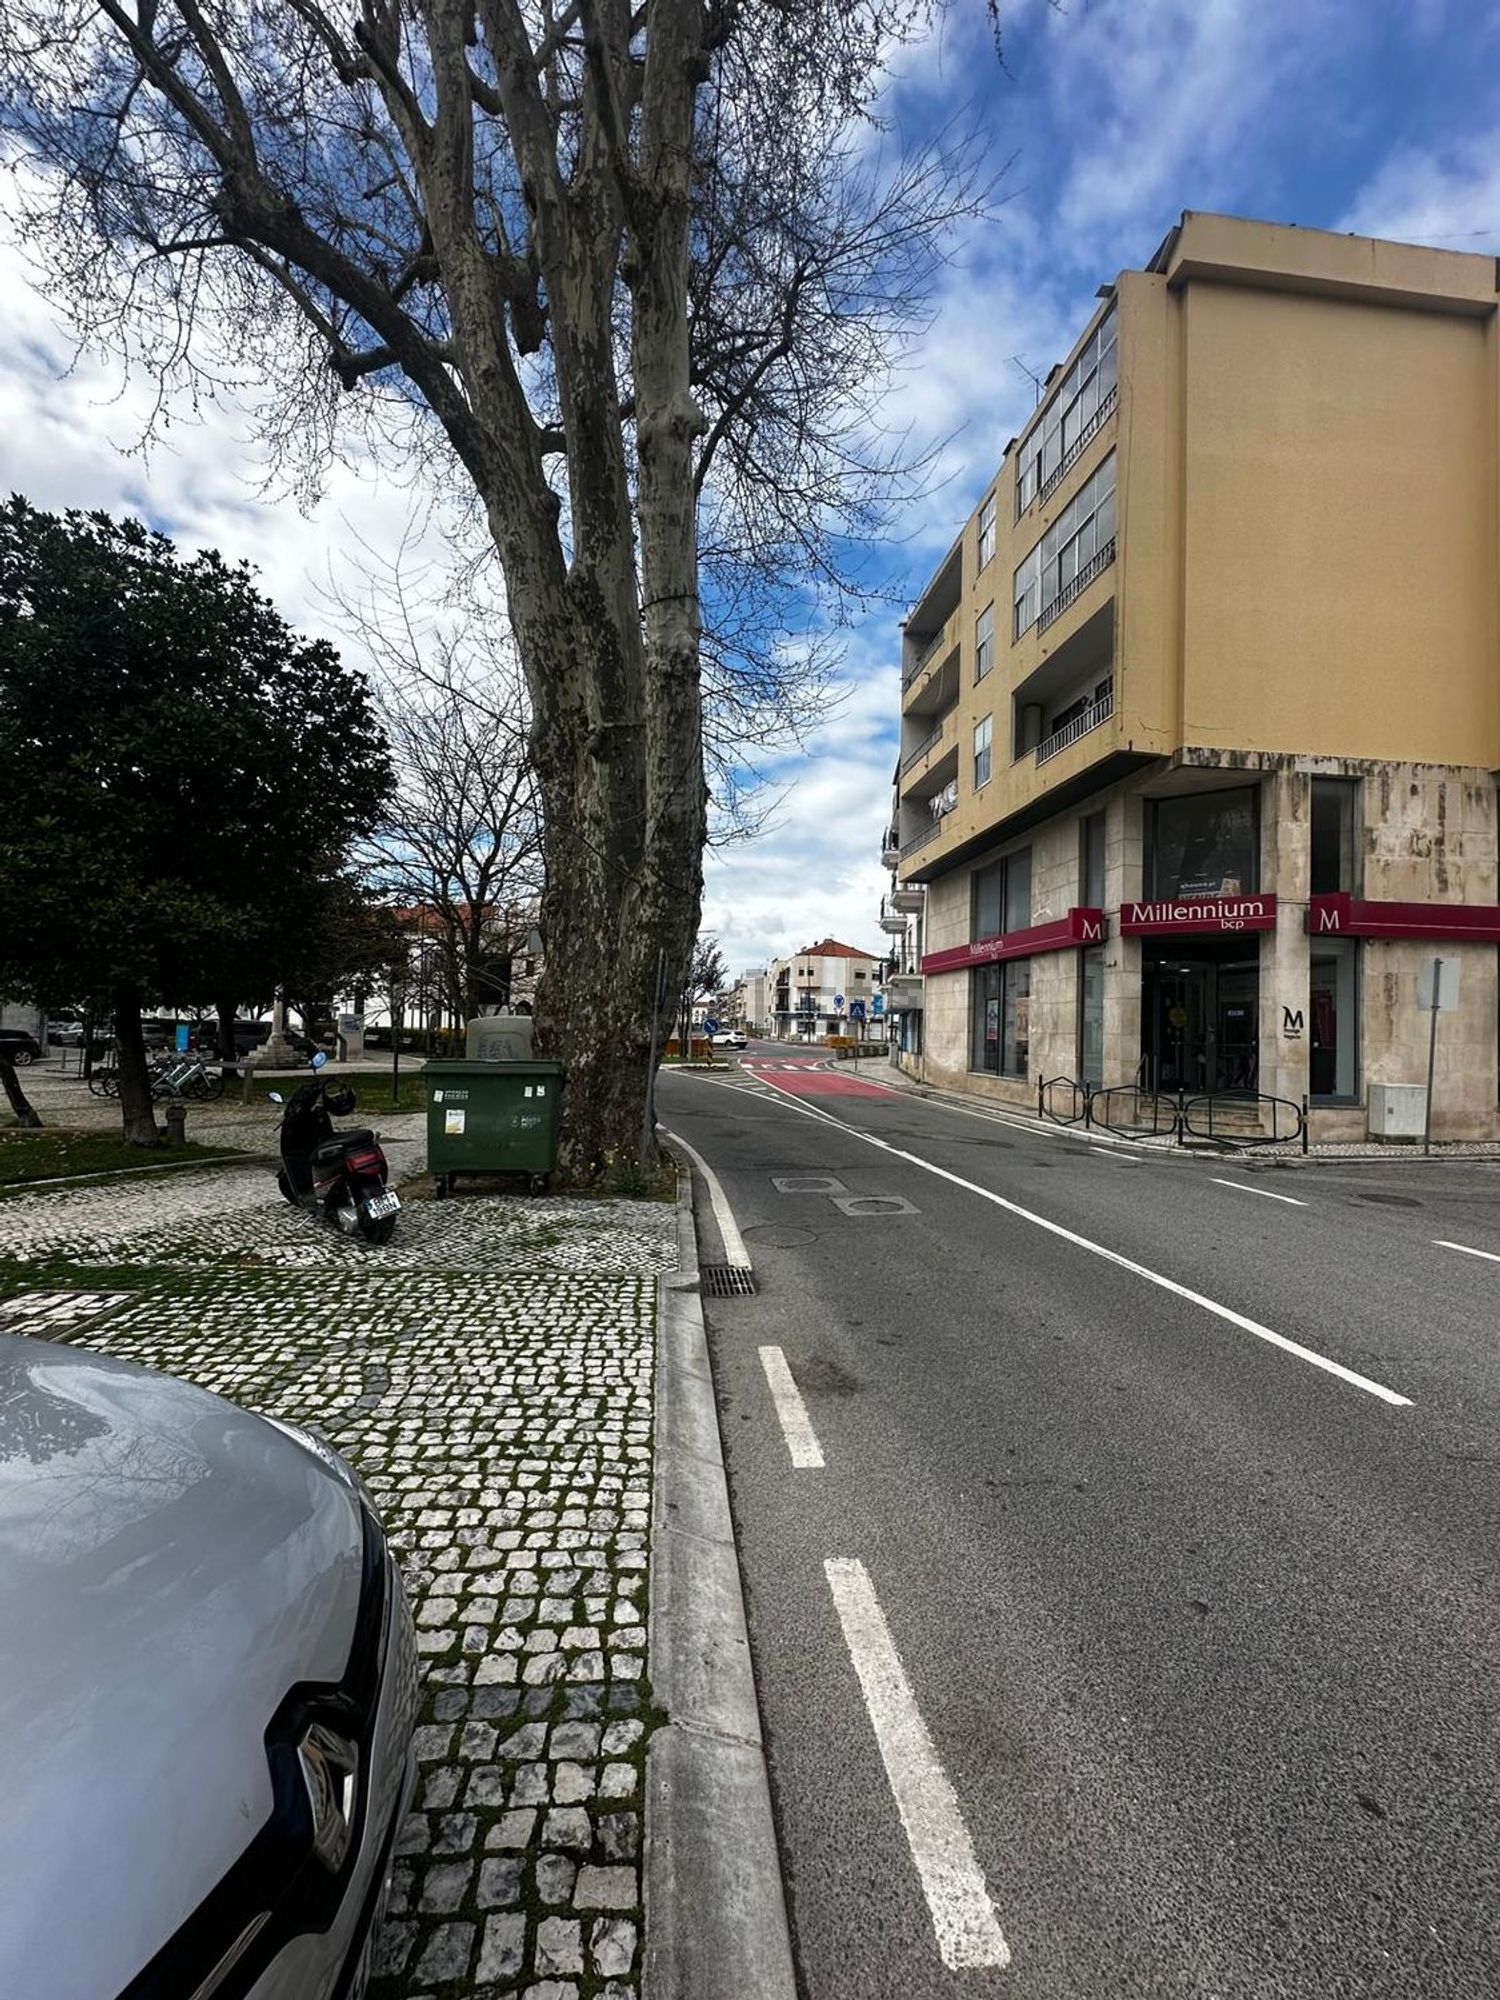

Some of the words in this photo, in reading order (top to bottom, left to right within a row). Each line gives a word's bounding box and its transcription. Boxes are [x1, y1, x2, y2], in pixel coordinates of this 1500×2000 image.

[1132, 900, 1263, 922] Millennium
[1320, 908, 1340, 931] M
[1082, 919, 1102, 940] M
[1221, 918, 1244, 930] bcp
[1282, 1005, 1304, 1029] M
